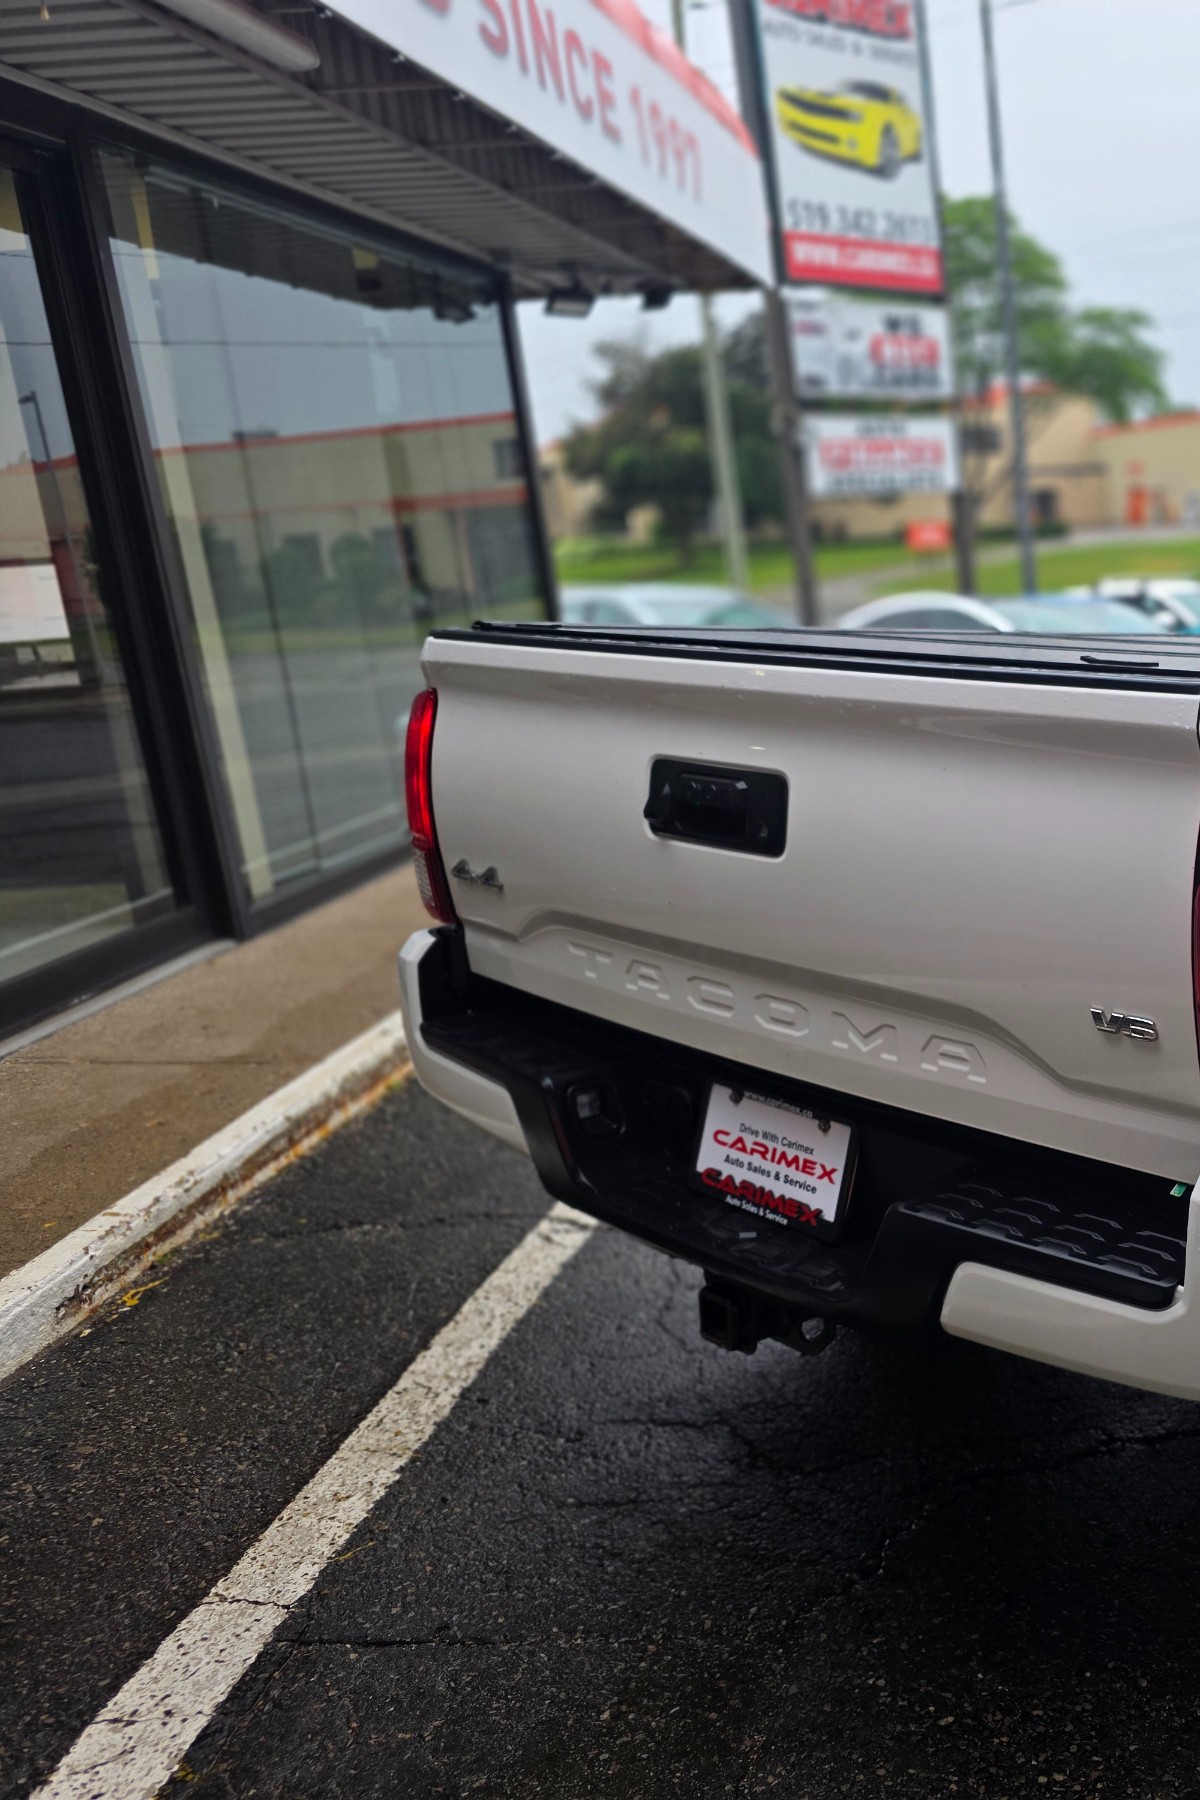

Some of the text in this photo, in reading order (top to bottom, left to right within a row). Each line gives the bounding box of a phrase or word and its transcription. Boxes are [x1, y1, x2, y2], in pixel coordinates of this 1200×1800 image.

[629, 83, 702, 204] 1997
[567, 941, 987, 1084] TACOMA
[1089, 1007, 1159, 1042] V6
[712, 1129, 838, 1185] CARIMEX
[739, 1122, 815, 1156] Drive With Carimex
[701, 1167, 823, 1227] CARIMEX
[724, 1154, 818, 1195] Auto Sales & Service
